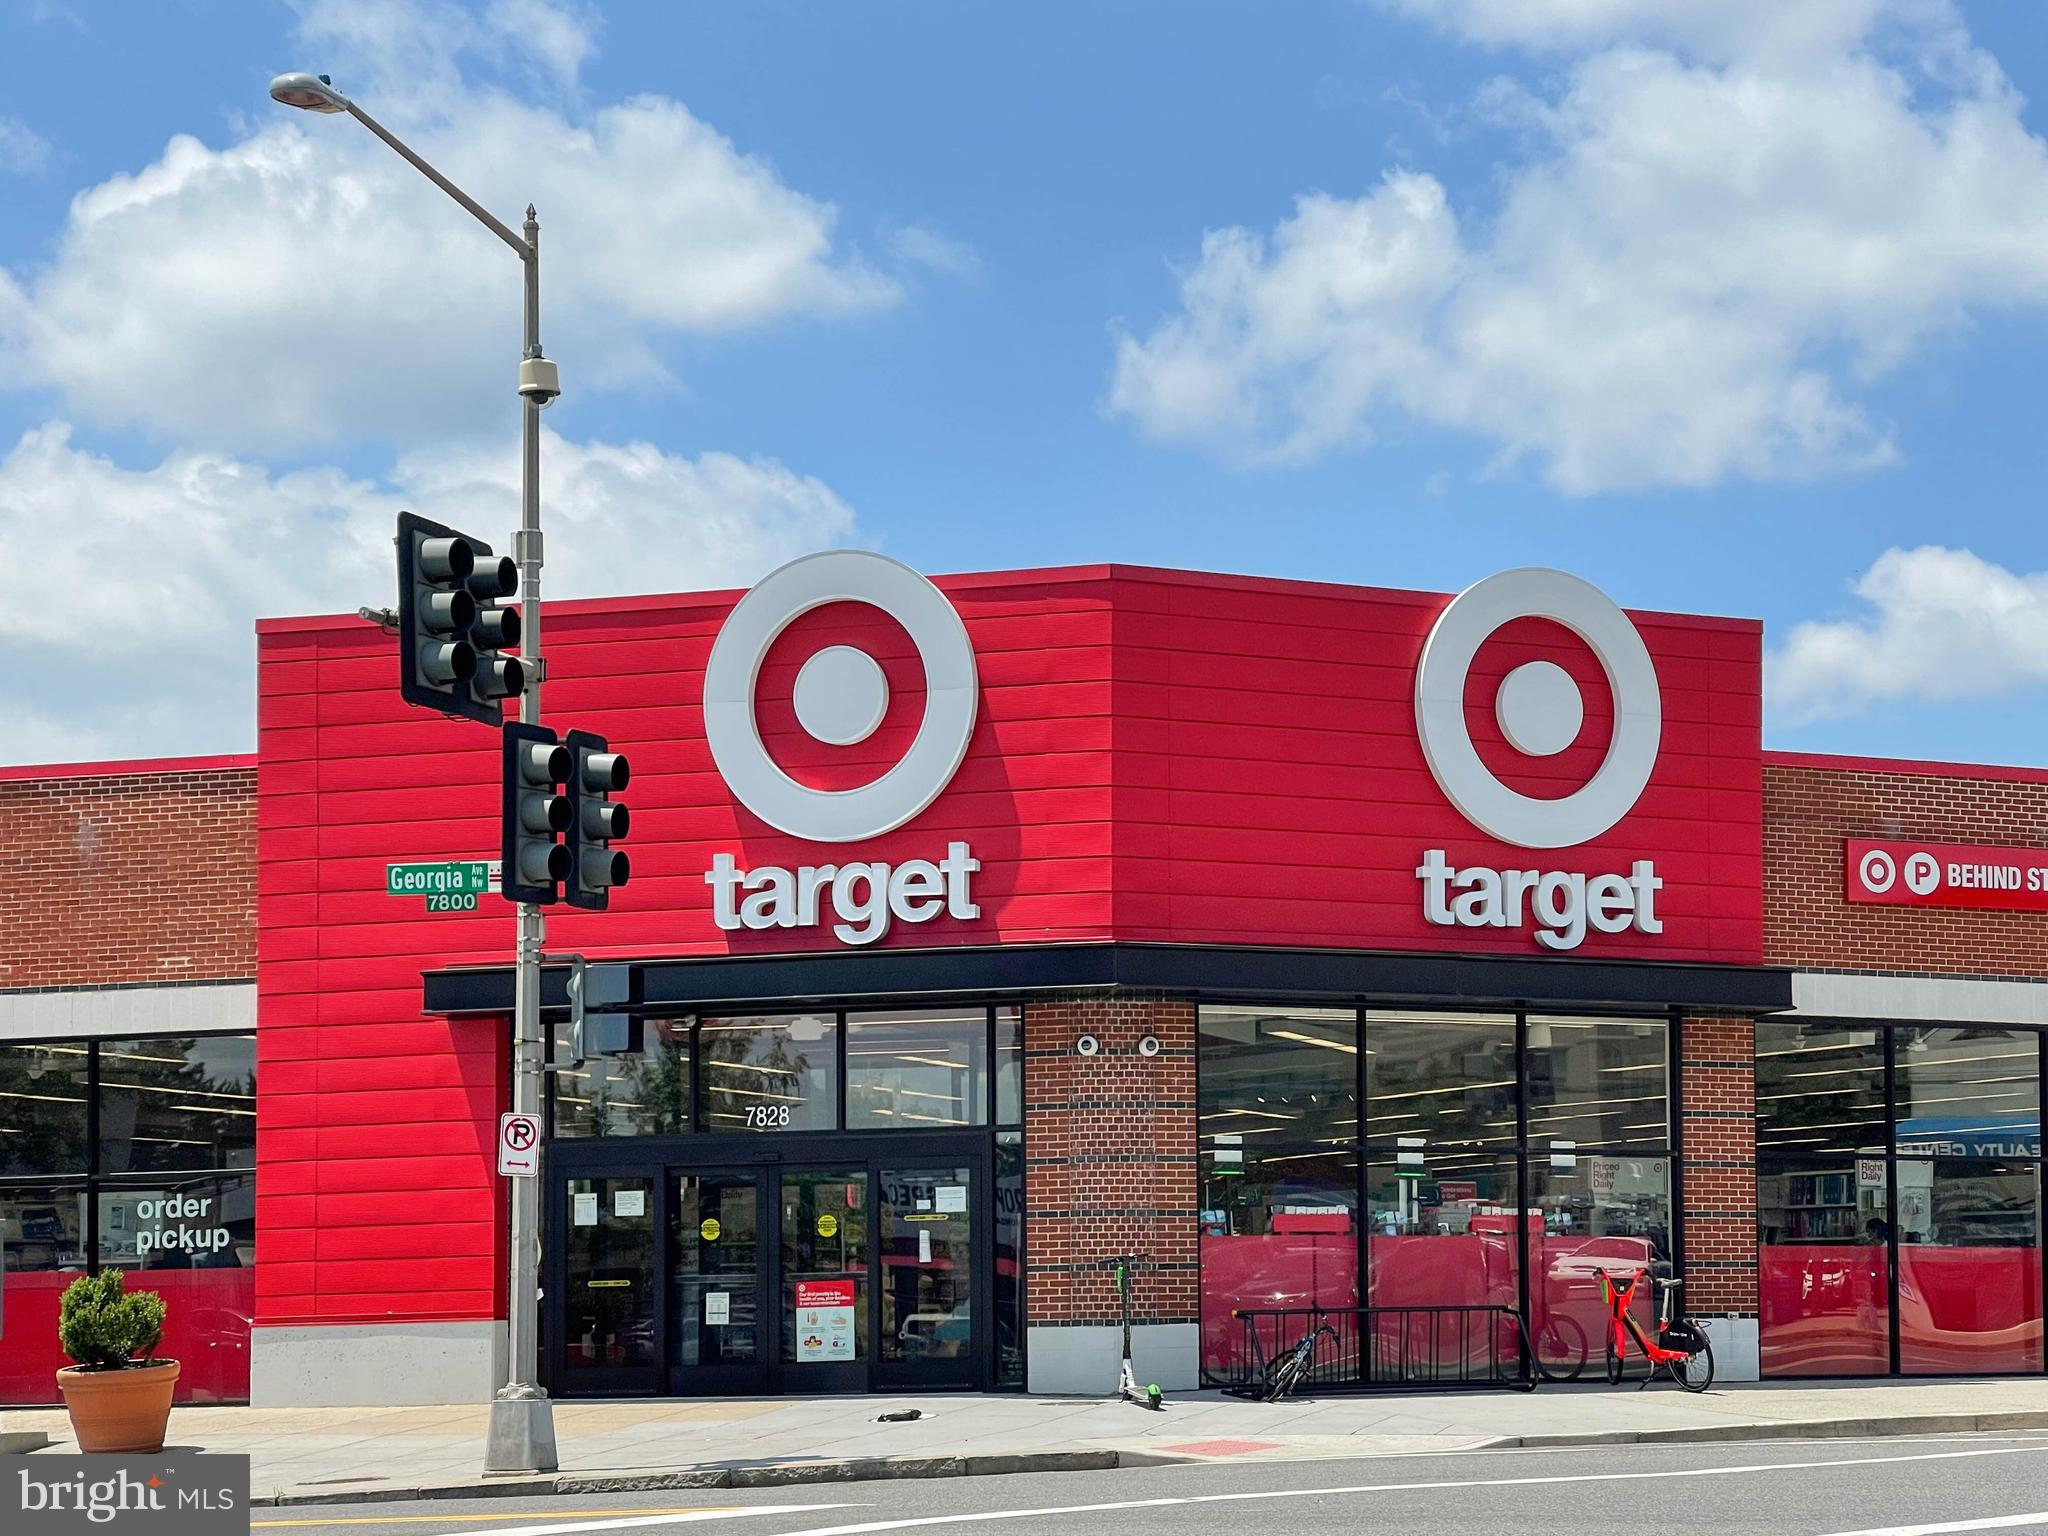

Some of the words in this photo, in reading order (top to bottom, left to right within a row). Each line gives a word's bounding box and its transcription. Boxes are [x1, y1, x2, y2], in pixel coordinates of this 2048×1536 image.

[390, 865, 463, 892] Georgia
[471, 864, 483, 876] Ave
[1947, 863, 2022, 890] BEHIND
[428, 893, 476, 911] 7800
[704, 841, 981, 945] target
[1415, 849, 1663, 950] target
[744, 1105, 790, 1127] 7828
[1593, 1161, 1620, 1171] Priced
[1861, 1162, 1883, 1173] Right
[1861, 1172, 1882, 1182] Daily
[136, 1193, 212, 1220] order
[136, 1223, 230, 1256] pickup
